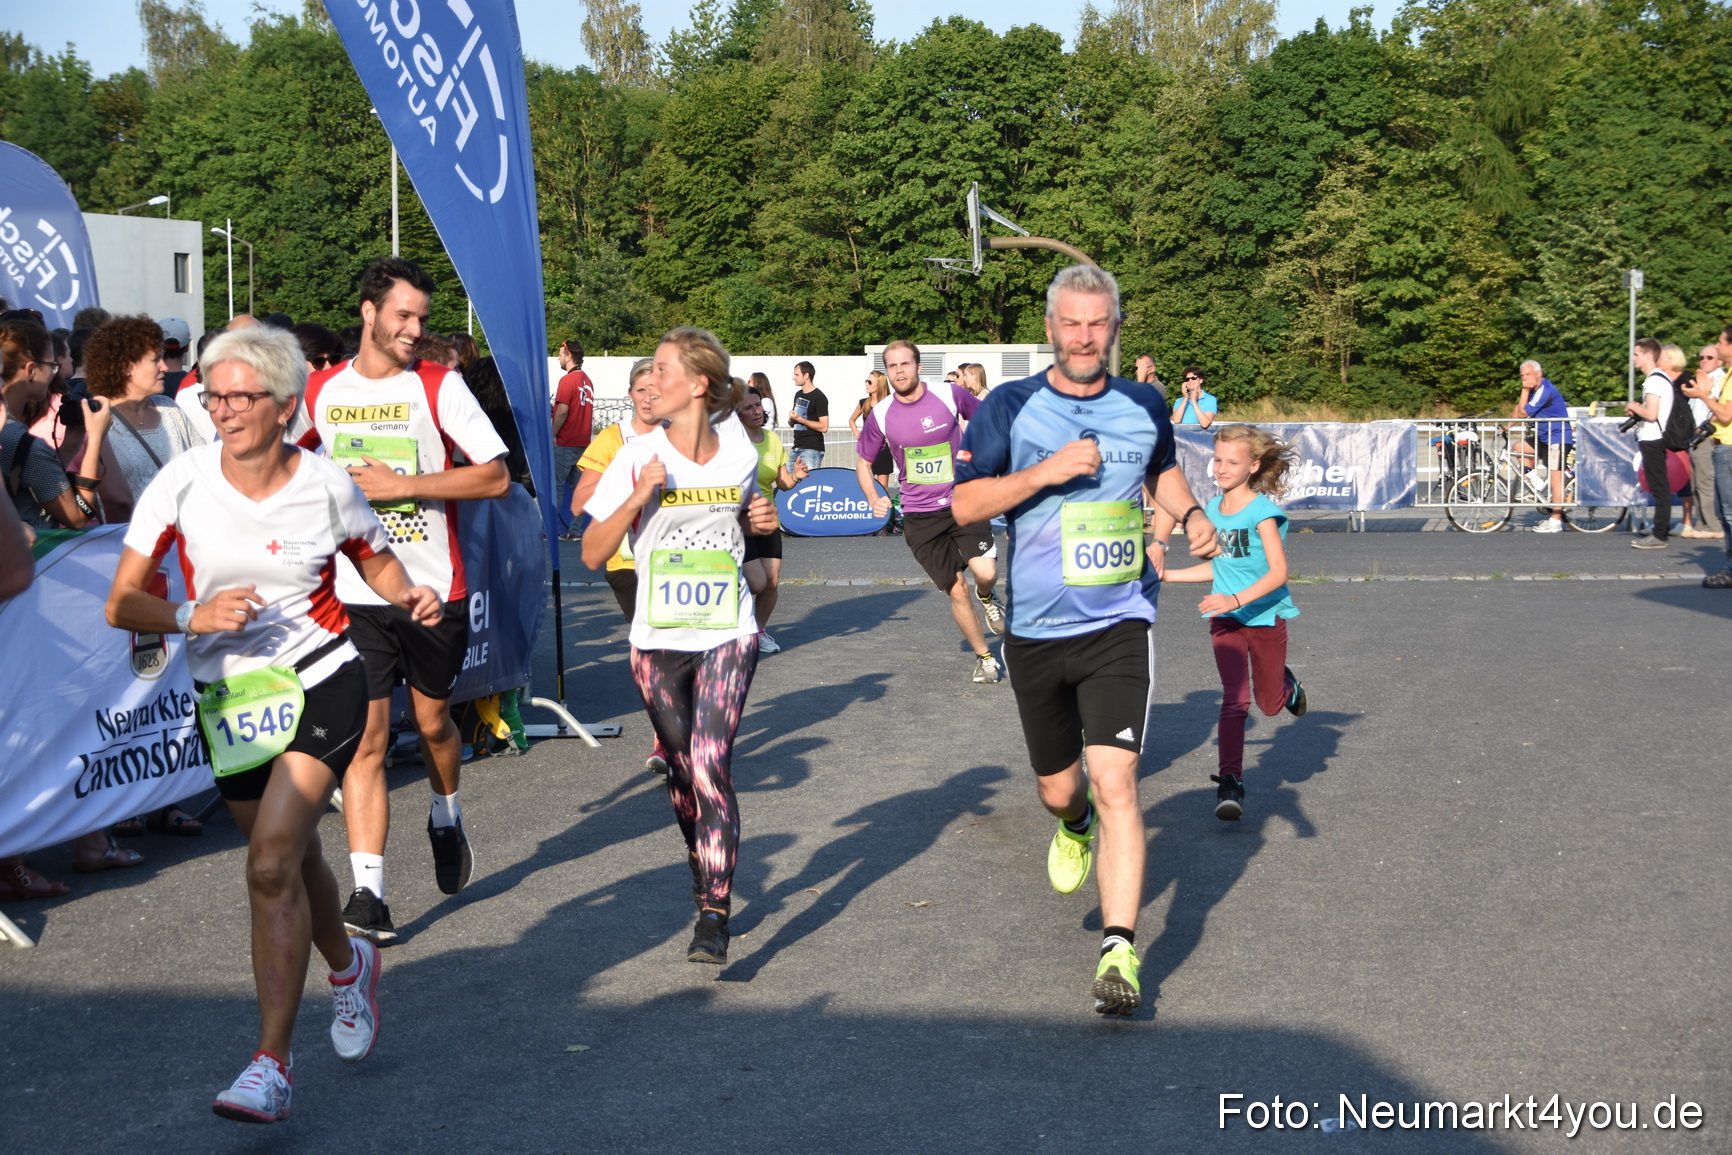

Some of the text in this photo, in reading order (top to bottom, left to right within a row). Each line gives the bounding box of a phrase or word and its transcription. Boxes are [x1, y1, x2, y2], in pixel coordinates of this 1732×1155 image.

[330, 405, 402, 421] ONLINE
[370, 423, 409, 432] Germany
[915, 460, 943, 474] 507
[76, 494, 93, 514] SONY
[664, 487, 738, 504] ONLINE
[812, 512, 873, 521] AUTOMOBILE
[1075, 539, 1135, 570] 6099
[659, 580, 729, 606] 1007
[138, 652, 160, 670] 1628
[216, 702, 295, 746] 1546
